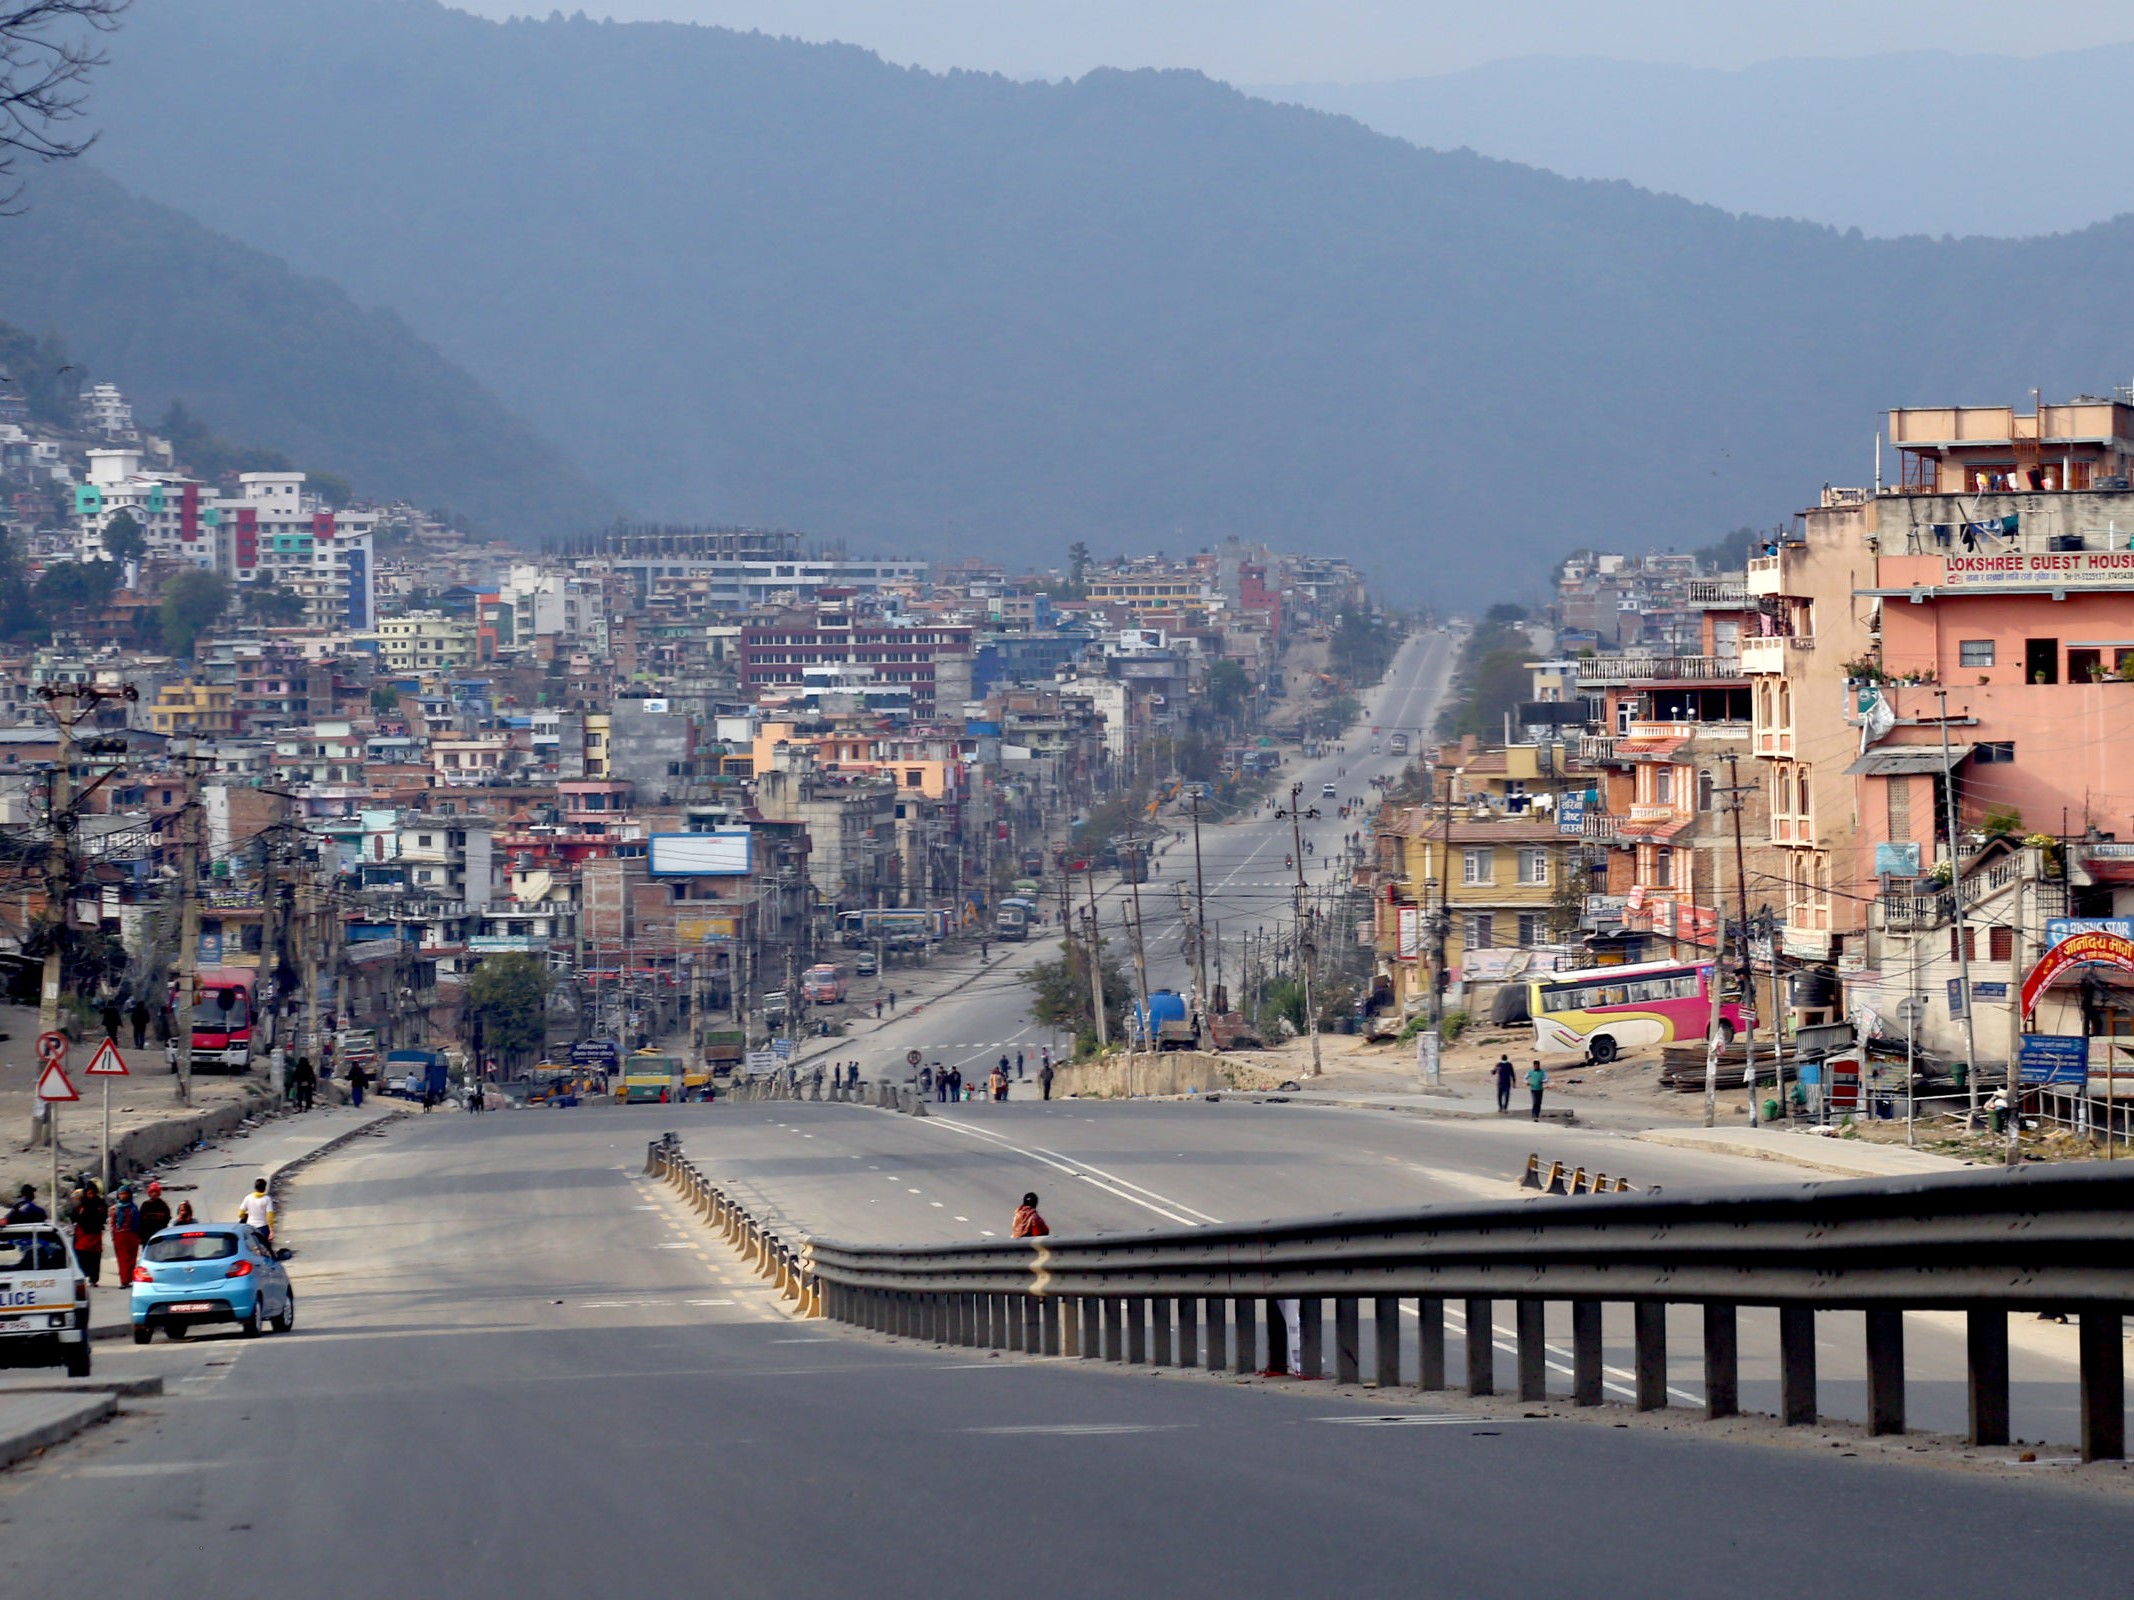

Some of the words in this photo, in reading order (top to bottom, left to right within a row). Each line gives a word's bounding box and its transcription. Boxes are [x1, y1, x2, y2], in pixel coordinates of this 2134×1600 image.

[1946, 556, 2024, 571] LOKSHREE
[2030, 555, 2081, 570] GUEST
[2070, 921, 2103, 934] RISING
[2105, 921, 2129, 936] STAR
[21, 1279, 56, 1288] POLICE
